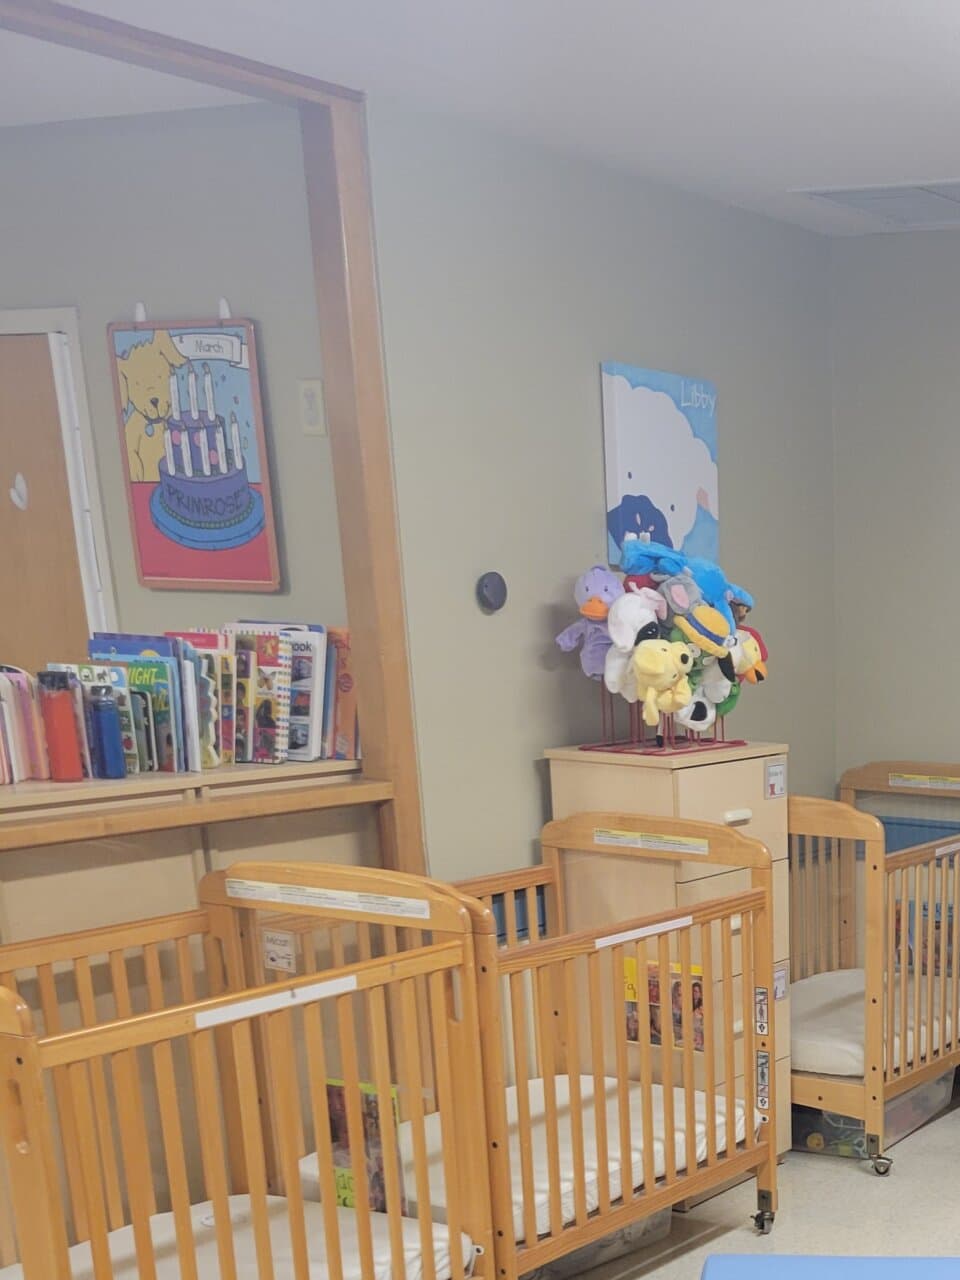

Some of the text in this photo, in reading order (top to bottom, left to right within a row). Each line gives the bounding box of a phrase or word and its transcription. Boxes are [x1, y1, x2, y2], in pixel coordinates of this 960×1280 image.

[195, 340, 224, 353] March
[680, 379, 717, 417] Libby
[166, 483, 243, 516] PRIMROSE
